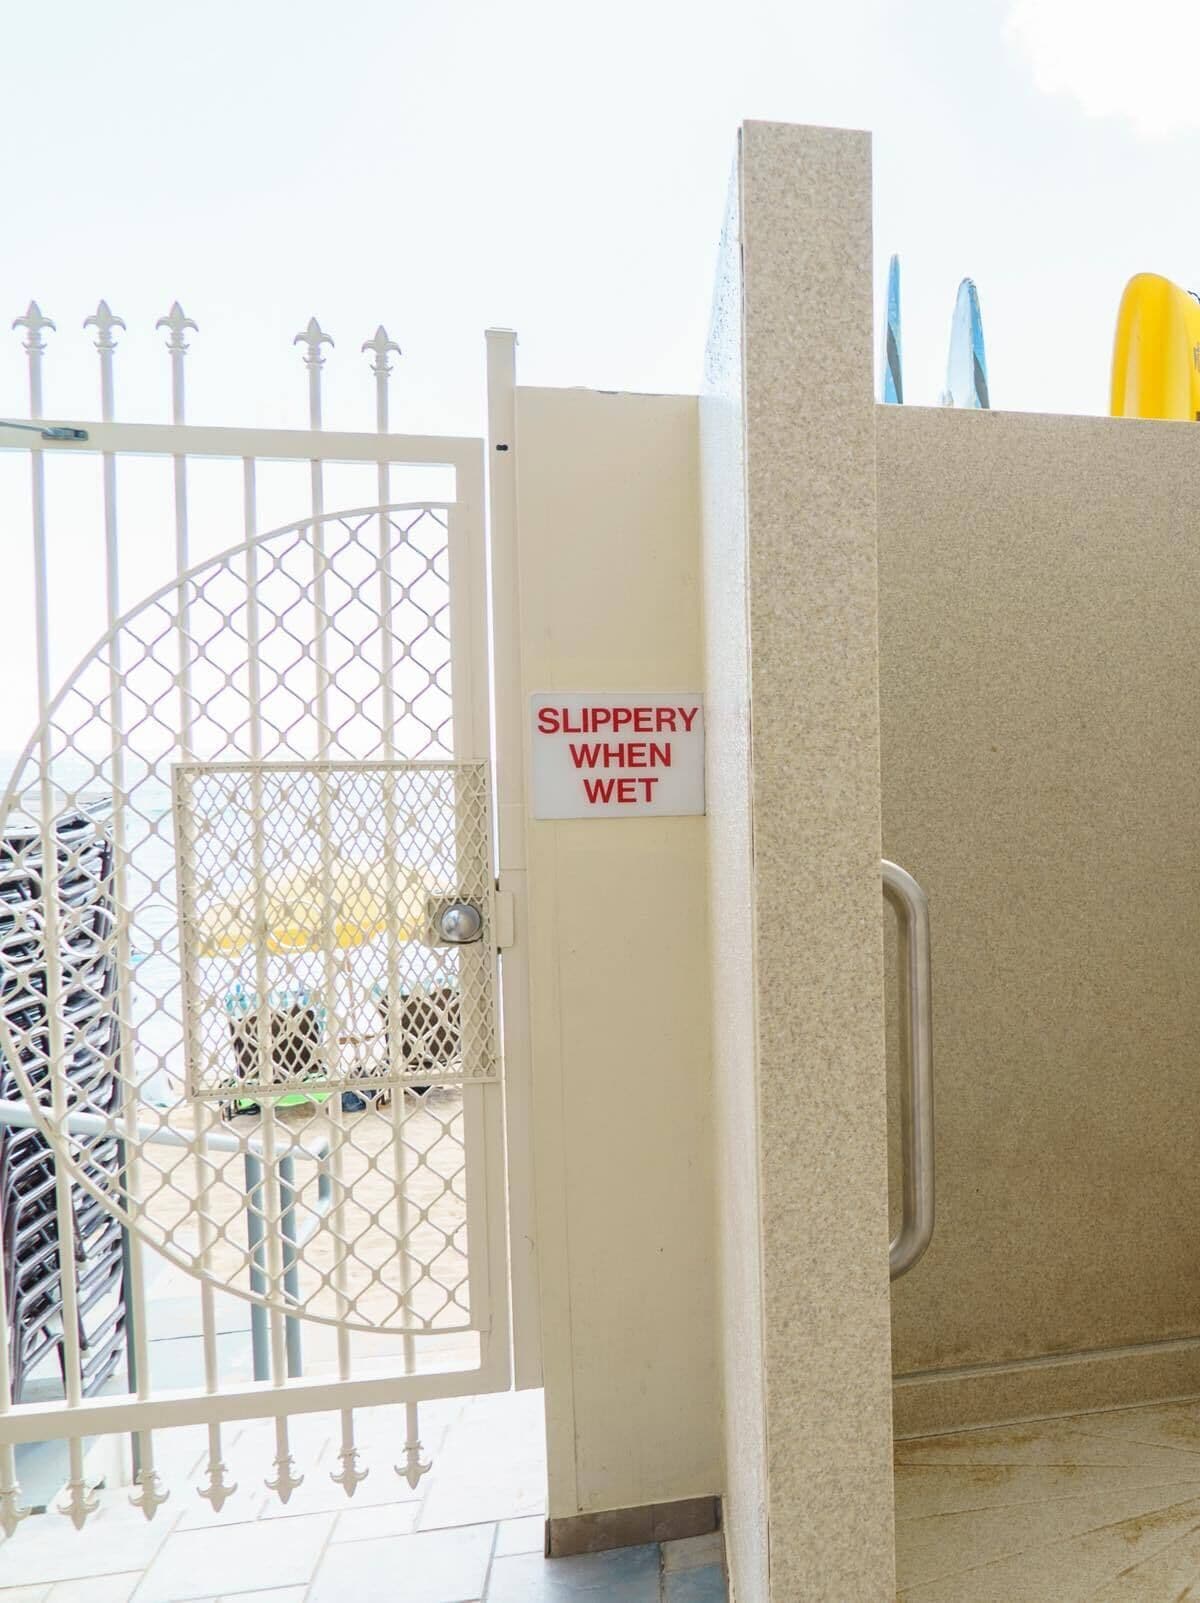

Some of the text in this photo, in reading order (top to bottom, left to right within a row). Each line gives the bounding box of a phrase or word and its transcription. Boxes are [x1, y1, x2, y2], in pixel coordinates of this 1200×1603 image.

[537, 707, 698, 734] SLIPPERY
[569, 742, 672, 768] WHEN
[583, 777, 659, 804] WET
